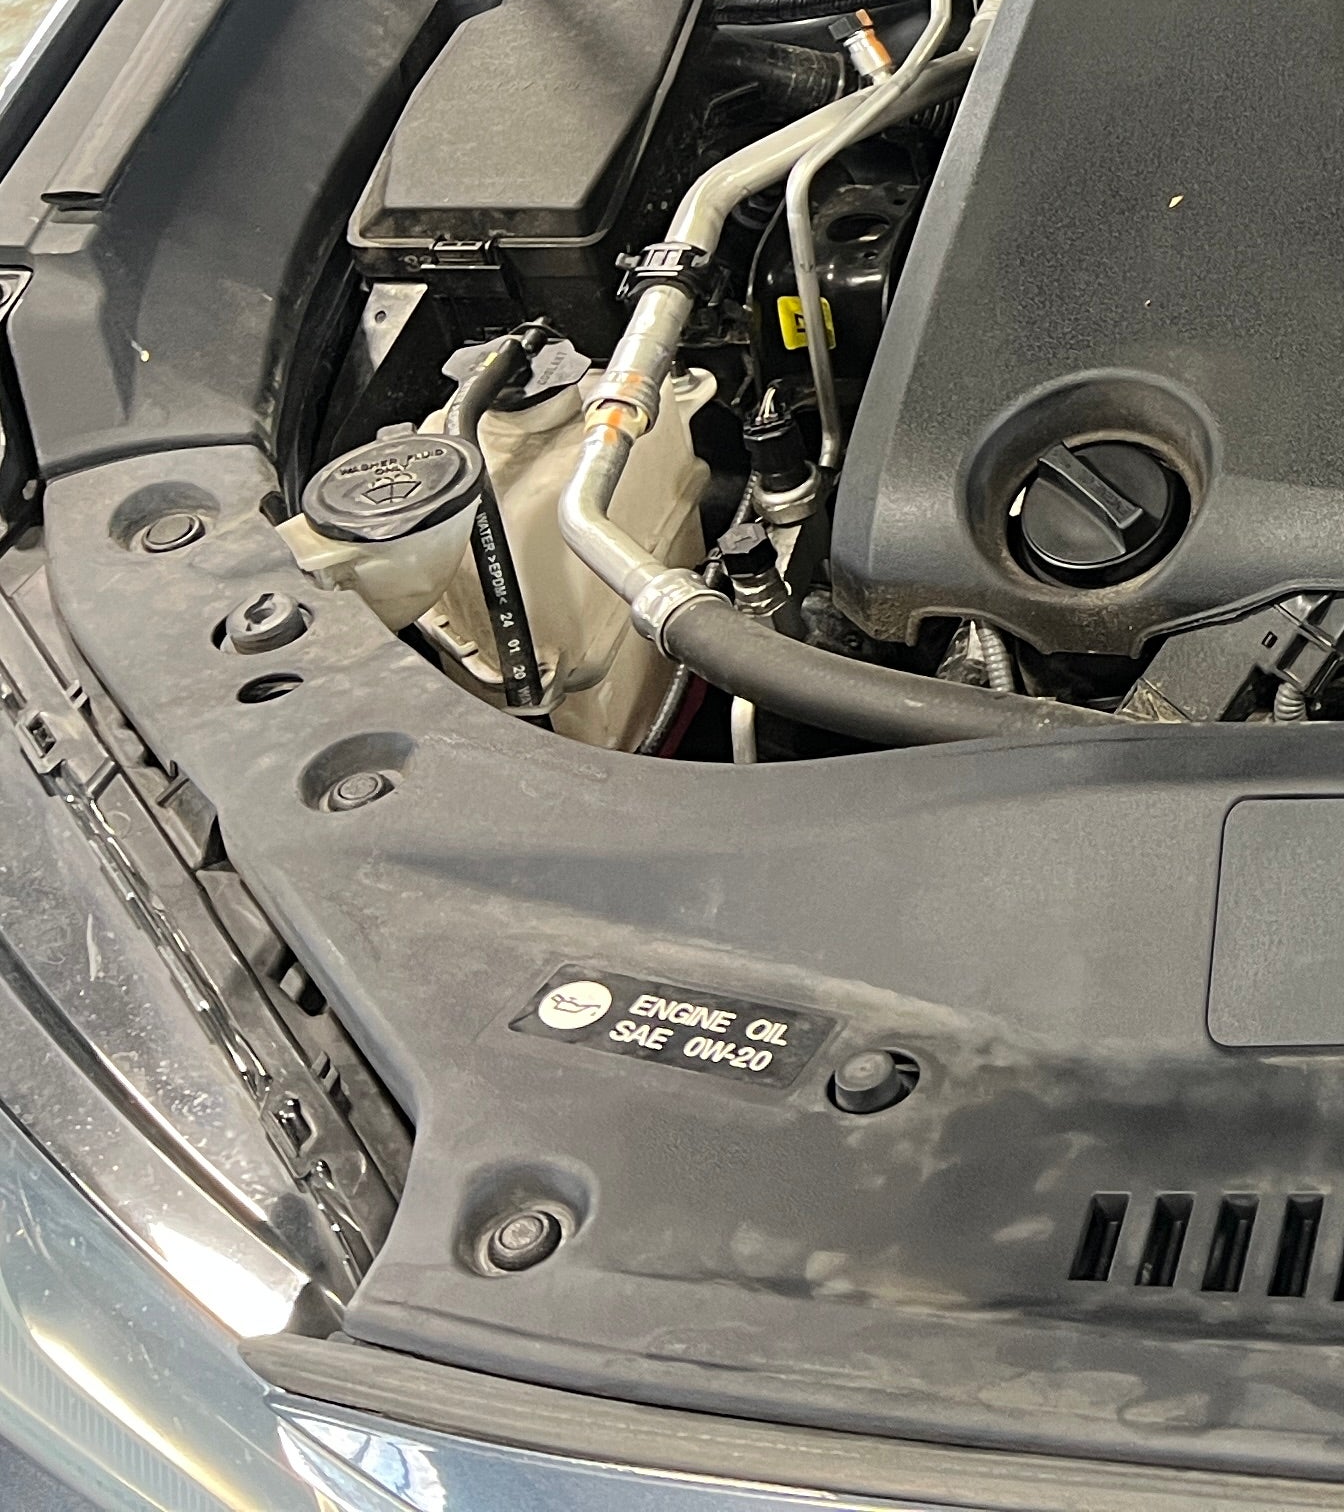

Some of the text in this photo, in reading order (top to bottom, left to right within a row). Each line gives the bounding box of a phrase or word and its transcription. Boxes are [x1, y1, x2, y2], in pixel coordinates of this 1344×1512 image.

[475, 511, 497, 553] WATER
[500, 612, 515, 628] 24
[507, 638, 521, 656] 01
[512, 664, 527, 681] 20
[629, 994, 789, 1047] ENGINE OIL
[608, 1019, 774, 1072] SAE 0W-20
